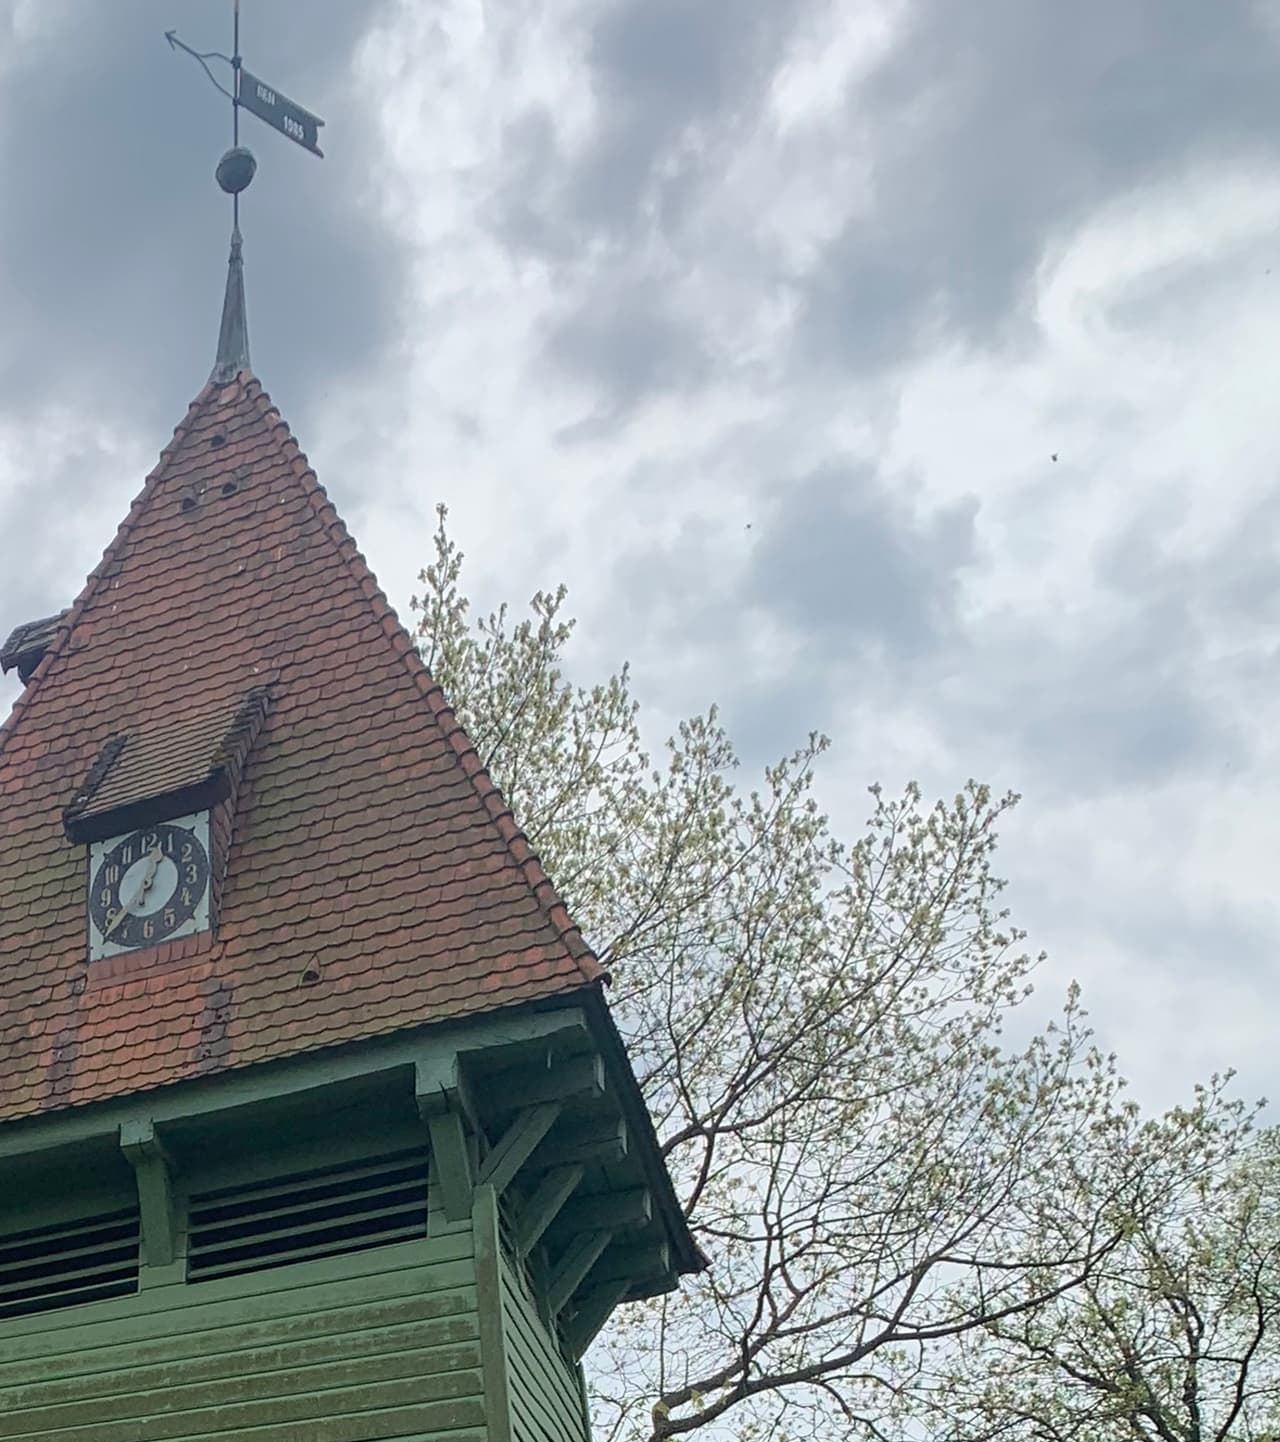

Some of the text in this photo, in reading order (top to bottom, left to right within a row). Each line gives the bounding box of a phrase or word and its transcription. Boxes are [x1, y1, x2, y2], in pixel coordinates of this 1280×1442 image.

[141, 833, 158, 854] 12
[167, 833, 174, 853] 1
[181, 843, 193, 863] 2
[122, 845, 132, 865] 11
[105, 864, 119, 886] 10
[186, 864, 198, 884] 3
[101, 888, 111, 907] 9
[181, 887, 192, 906] 4
[104, 907, 117, 928] 8
[164, 908, 175, 928] 5
[121, 921, 128, 939] 7
[143, 920, 154, 938] 6
